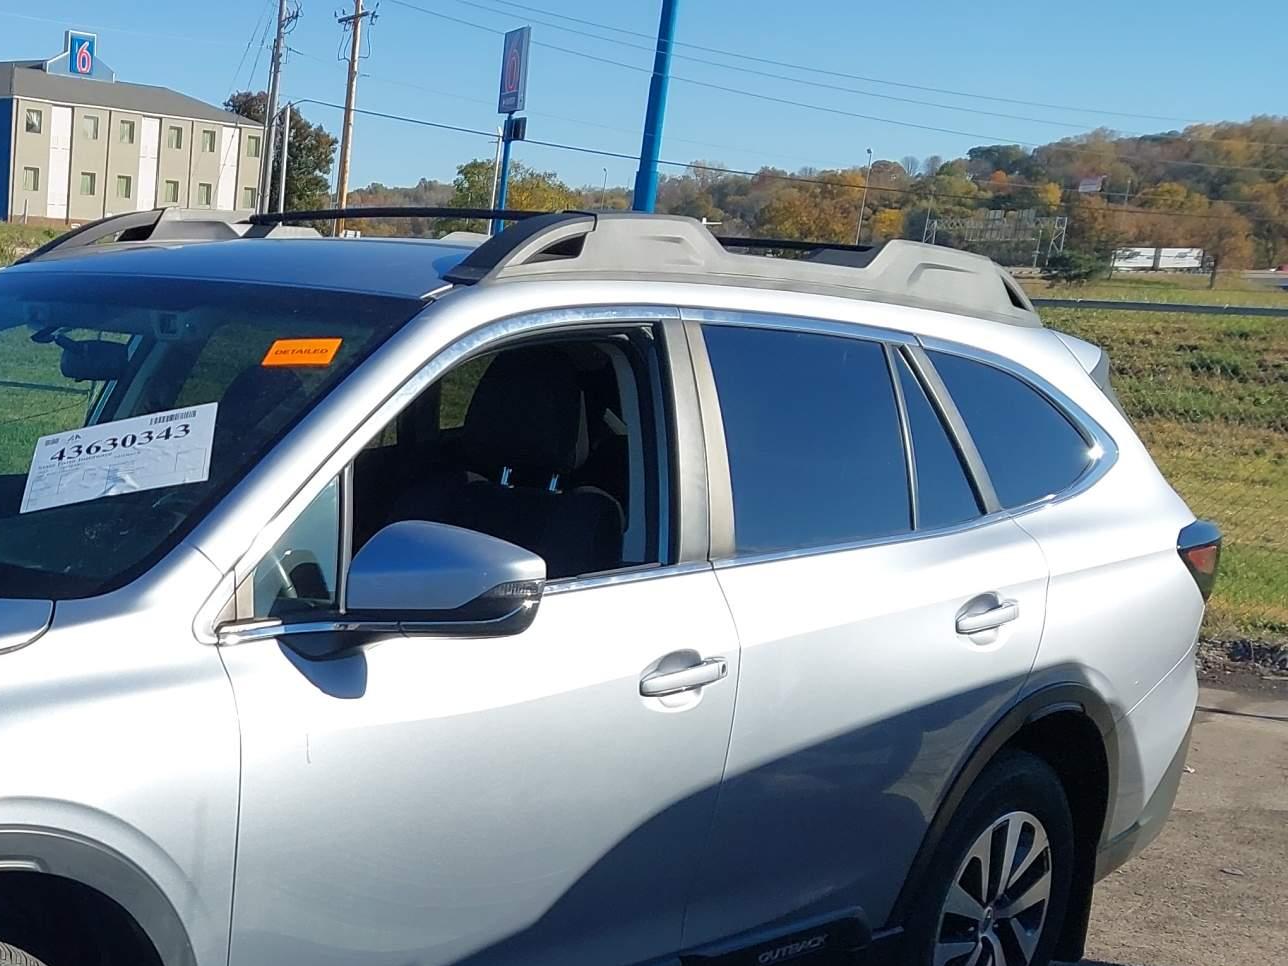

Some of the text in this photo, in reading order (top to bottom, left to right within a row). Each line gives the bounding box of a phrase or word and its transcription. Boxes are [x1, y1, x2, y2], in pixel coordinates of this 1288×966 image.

[77, 41, 91, 73] 6
[274, 348, 329, 356] DETAILED
[50, 424, 191, 462] 43630343
